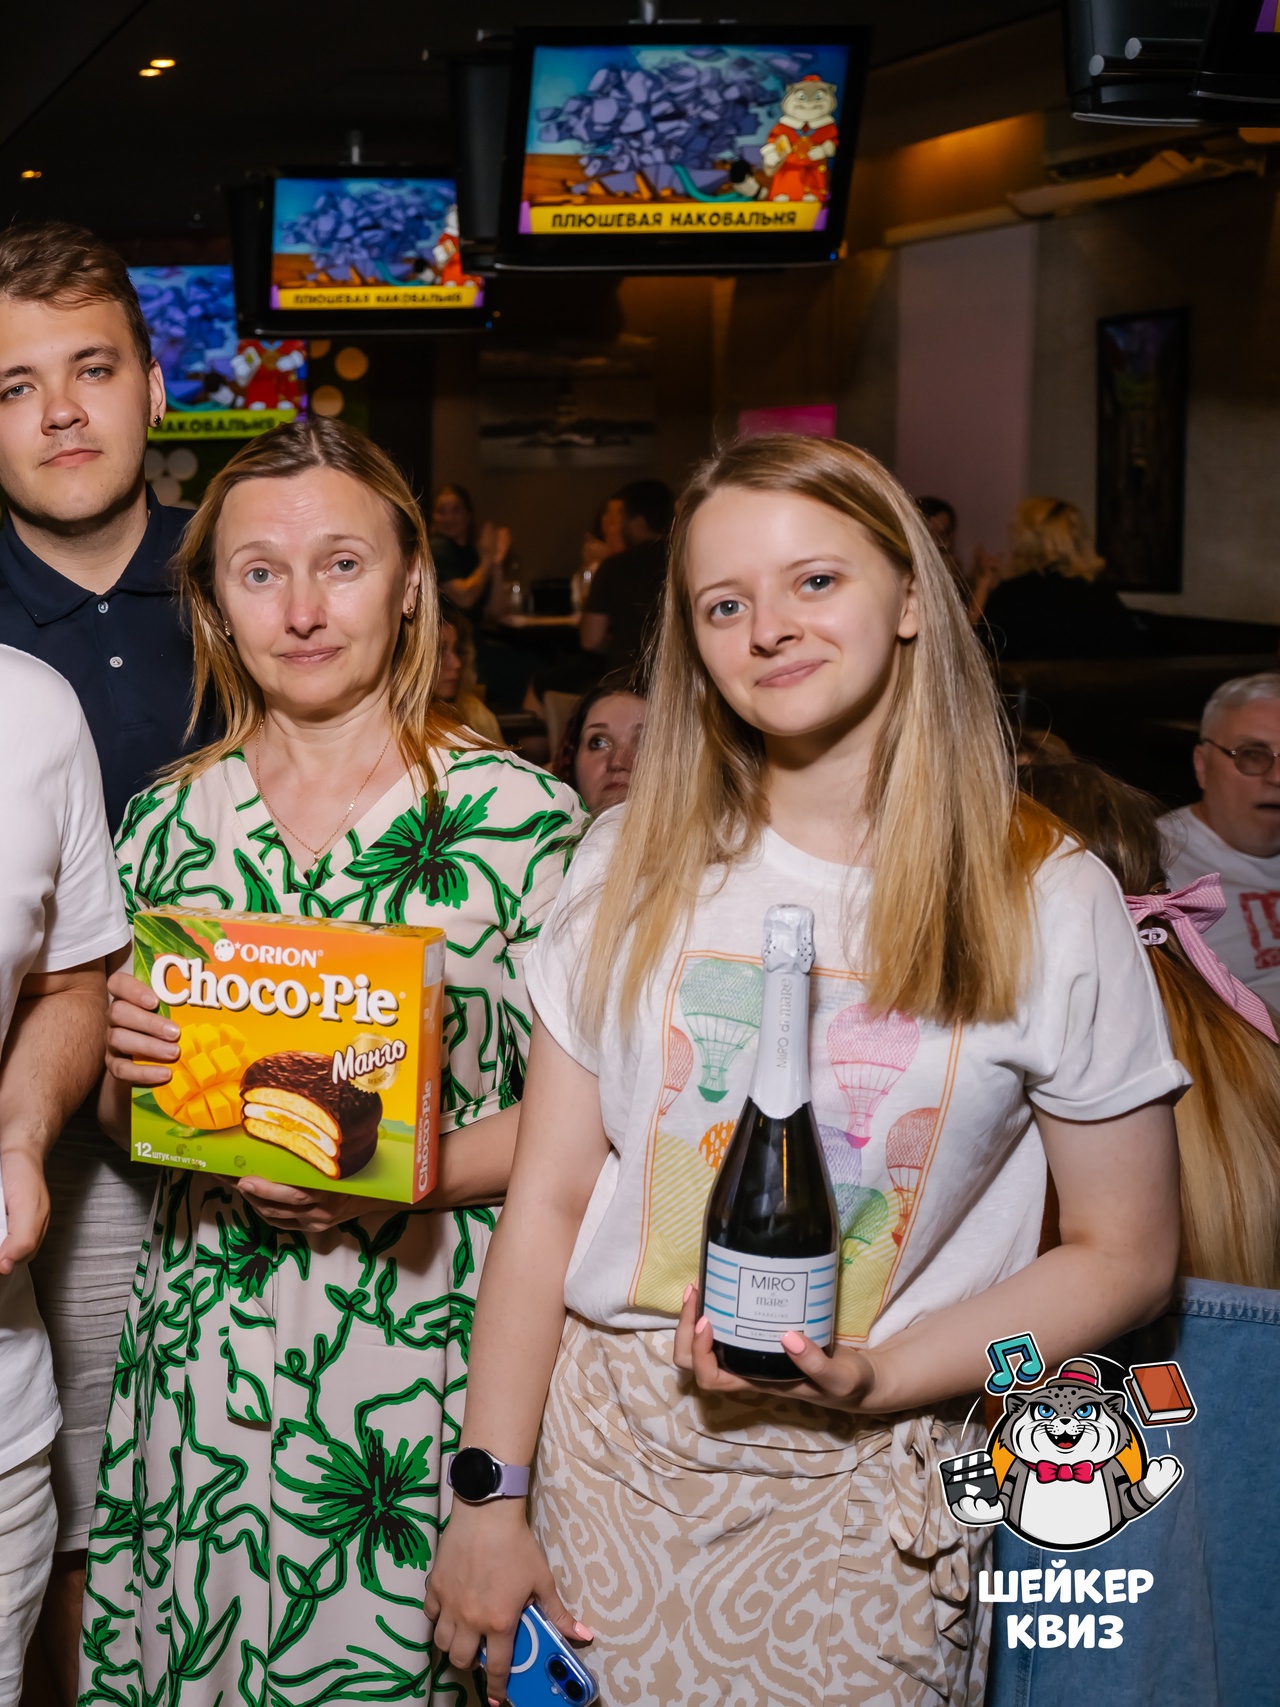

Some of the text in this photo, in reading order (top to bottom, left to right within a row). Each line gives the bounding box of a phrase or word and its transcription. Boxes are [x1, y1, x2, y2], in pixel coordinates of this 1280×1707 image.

[551, 211, 797, 228] ПЛЮШЕВАЯ НАКОВАЛЬНЯ
[239, 942, 317, 969] ORION
[331, 1039, 408, 1085] Манго
[776, 1036, 790, 1069] MIRO
[134, 1141, 153, 1158] 12
[751, 1275, 796, 1292] MIRO
